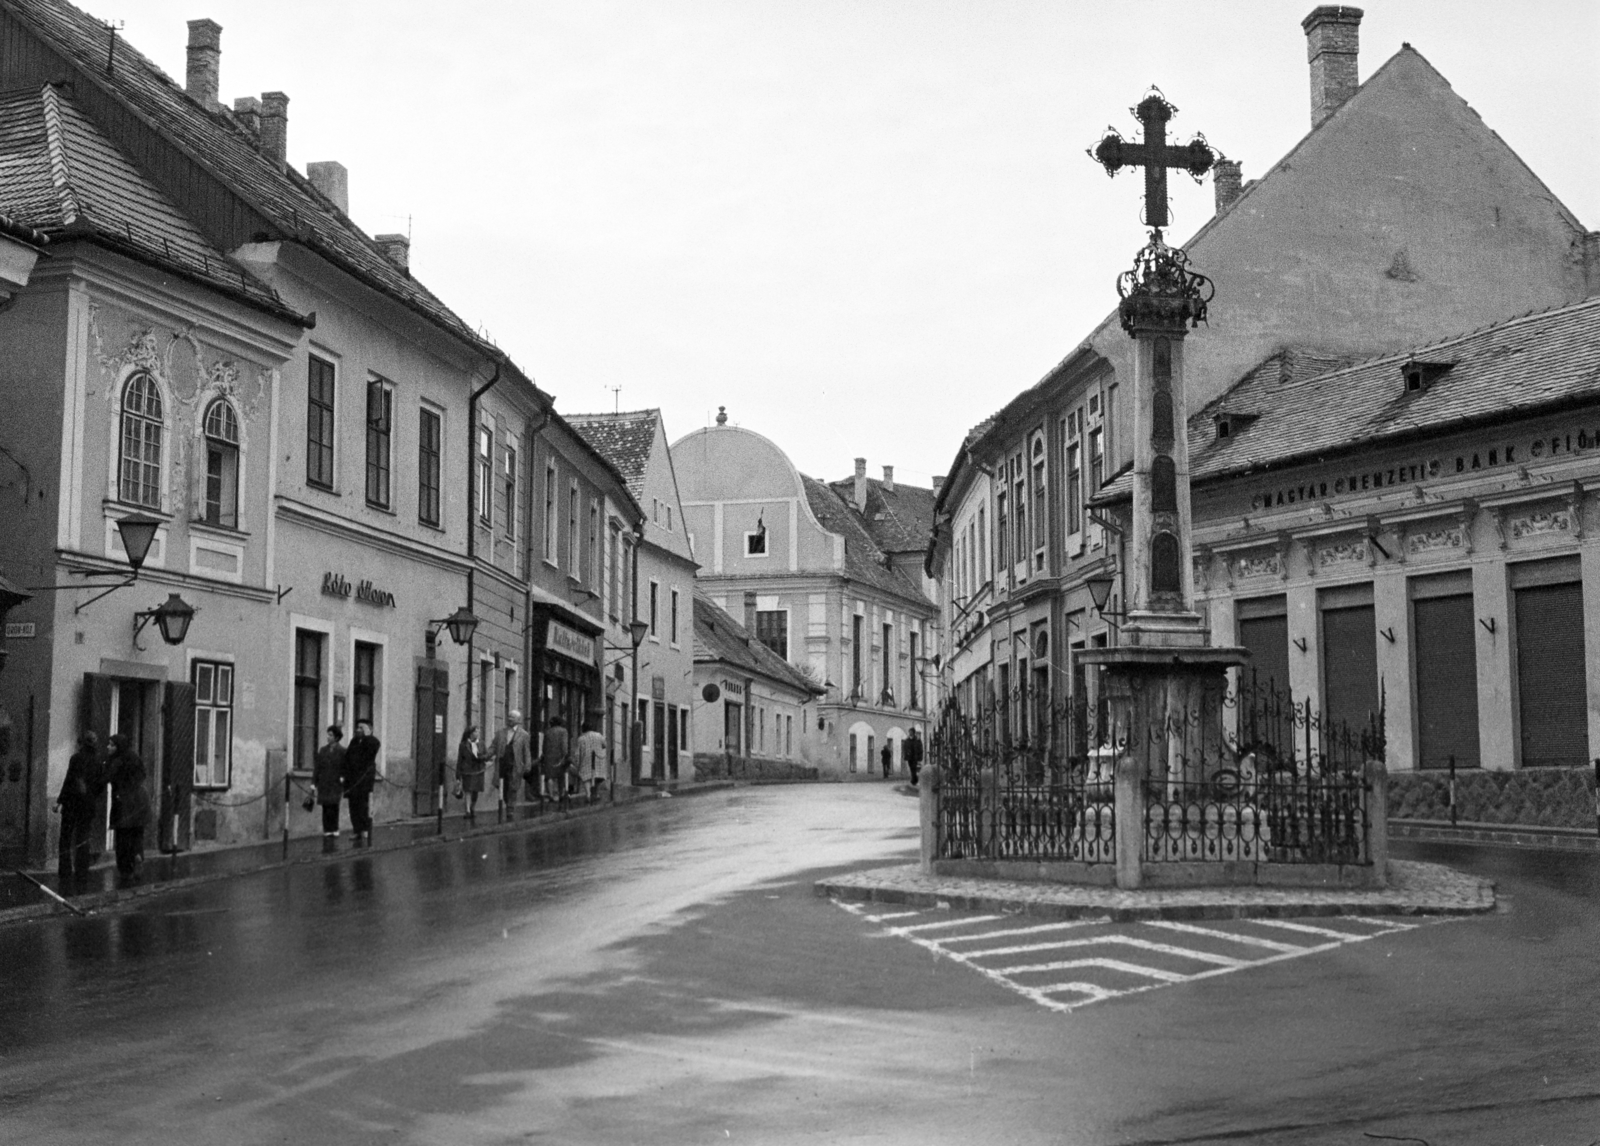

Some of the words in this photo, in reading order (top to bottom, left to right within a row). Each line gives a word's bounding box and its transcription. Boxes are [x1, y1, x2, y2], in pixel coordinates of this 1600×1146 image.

[1263, 482, 1328, 508] MAGYAR
[1349, 464, 1425, 492] NEMZETI
[1455, 445, 1515, 473] BANK
